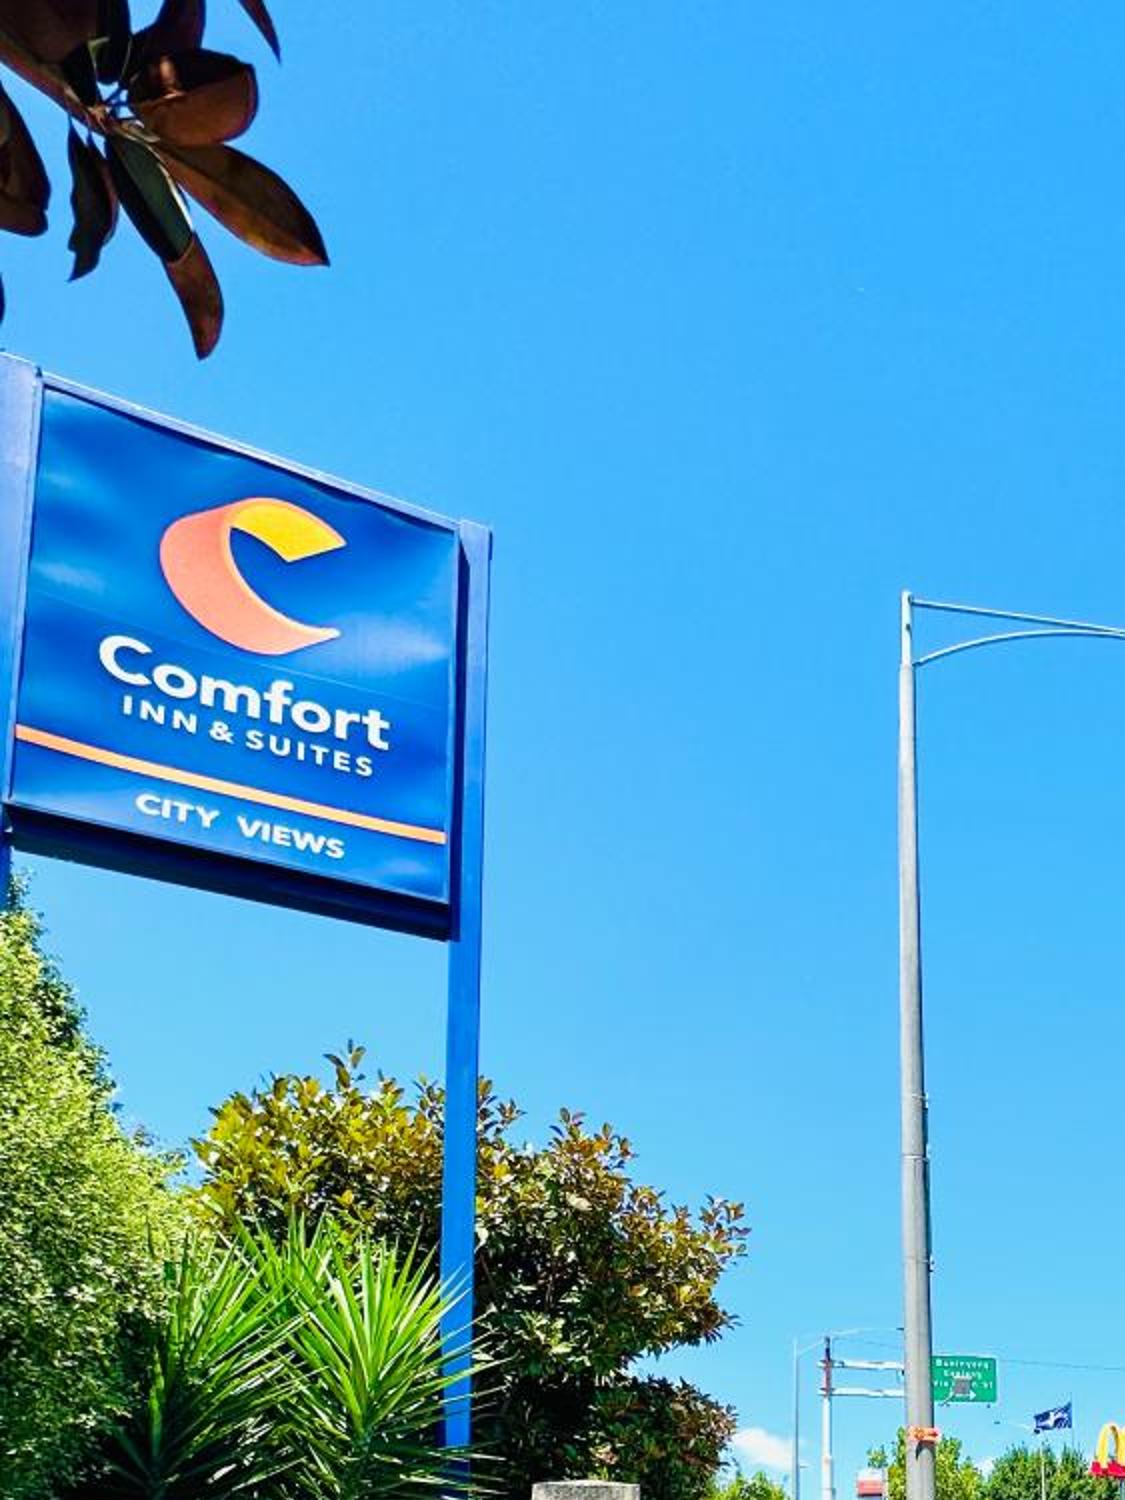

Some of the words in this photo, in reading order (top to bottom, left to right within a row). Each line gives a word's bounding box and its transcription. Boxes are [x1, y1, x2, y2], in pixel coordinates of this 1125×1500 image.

[99, 634, 391, 750] Comfort
[123, 695, 197, 734] INN
[209, 720, 234, 744] &
[245, 729, 373, 777] SUITES
[135, 793, 219, 829] CITY
[236, 816, 345, 860] VIEWS
